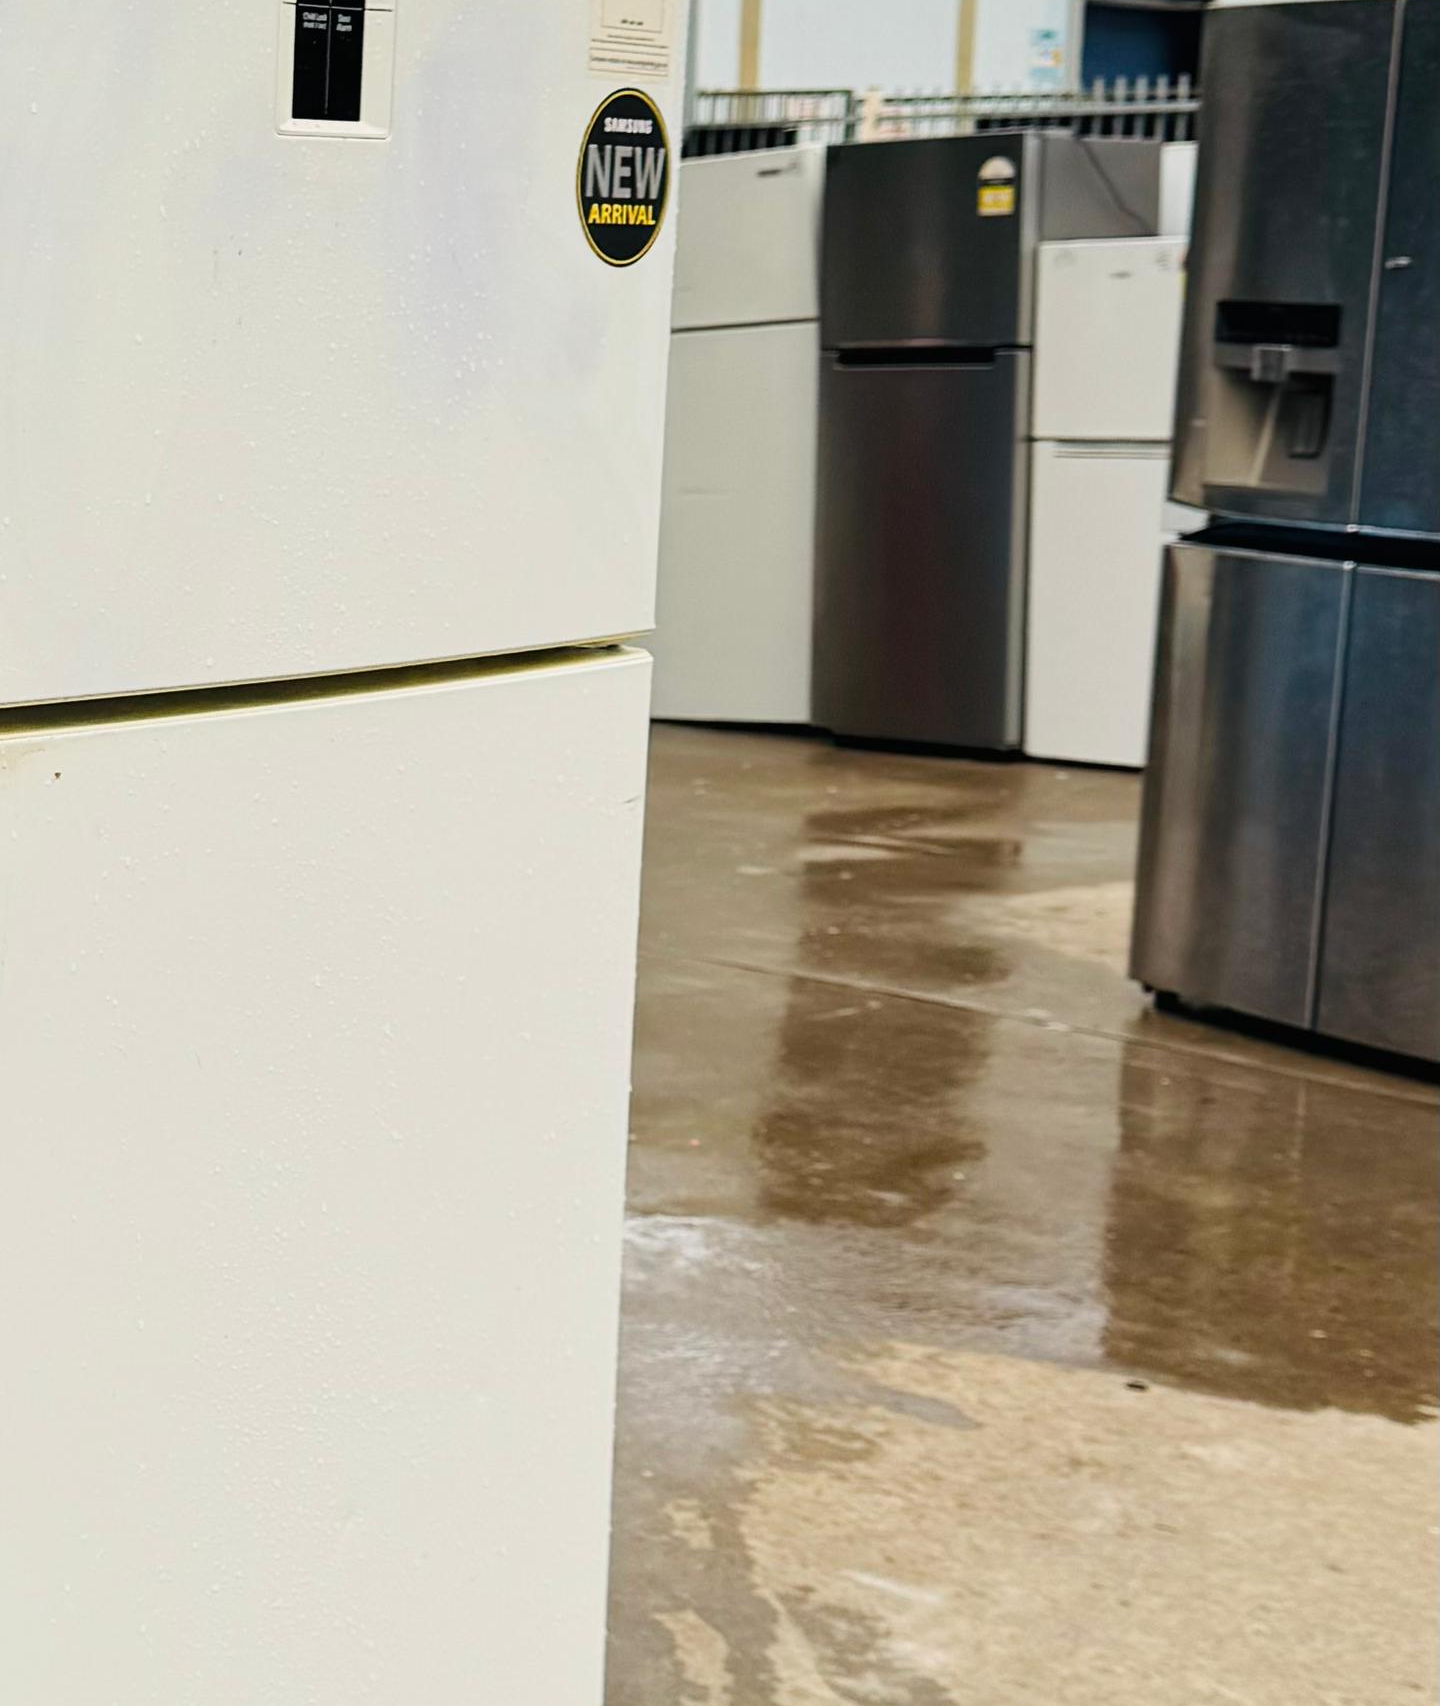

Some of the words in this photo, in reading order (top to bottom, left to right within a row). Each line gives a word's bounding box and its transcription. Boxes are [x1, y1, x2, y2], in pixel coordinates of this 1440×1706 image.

[604, 117, 653, 134] SAMSUNG
[585, 144, 666, 199] NEW
[588, 203, 656, 225] ARRIVAL
